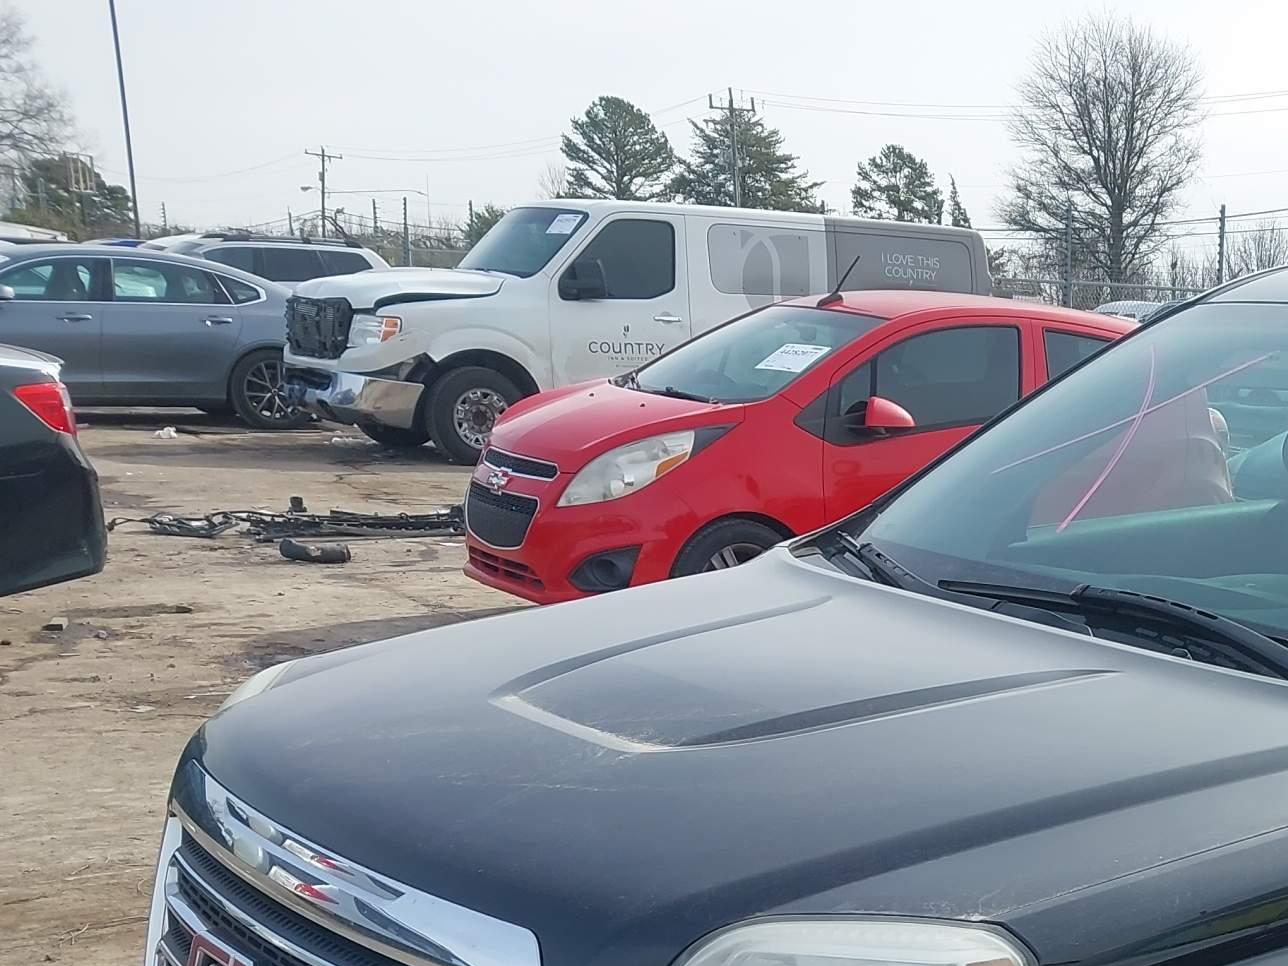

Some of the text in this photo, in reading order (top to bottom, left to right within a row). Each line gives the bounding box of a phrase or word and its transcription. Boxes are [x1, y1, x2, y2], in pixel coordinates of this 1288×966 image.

[887, 253, 915, 266] LOVE
[917, 255, 940, 269] THIS
[885, 266, 936, 280] COUNTRY
[588, 341, 665, 355] COUNTRY
